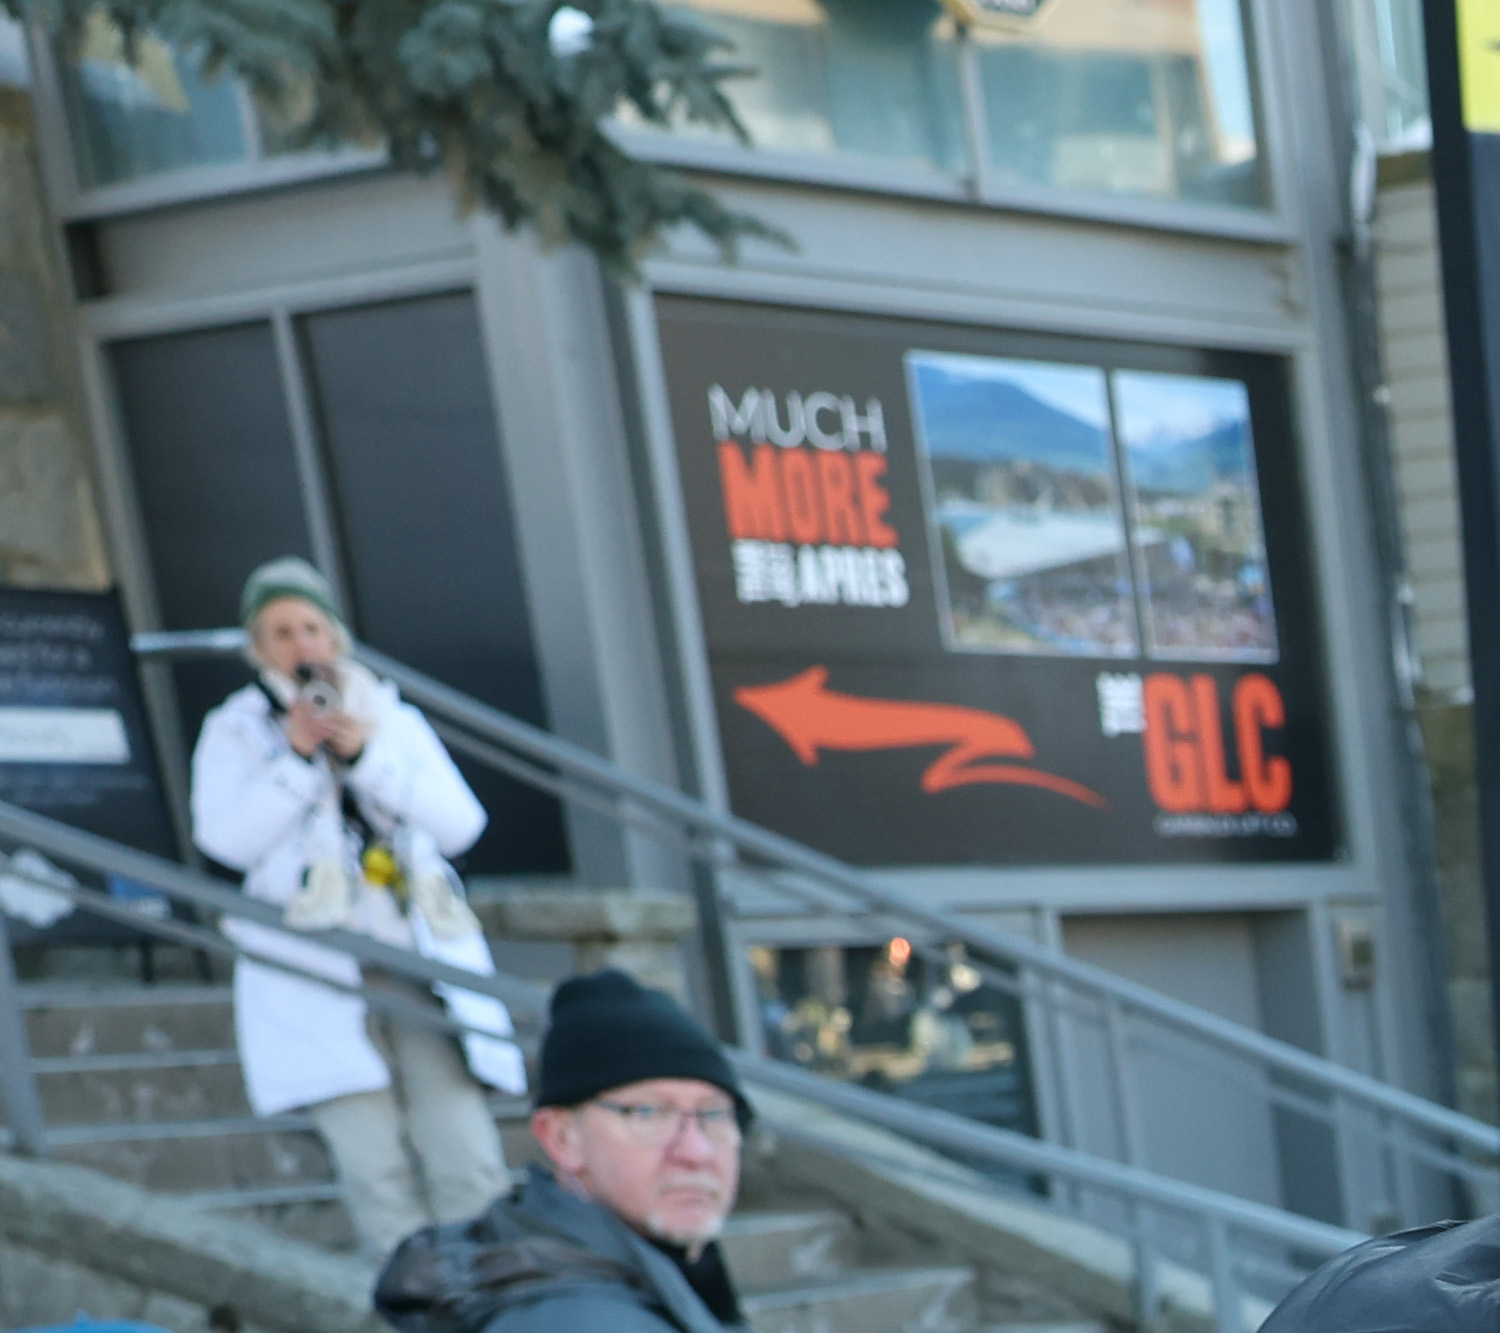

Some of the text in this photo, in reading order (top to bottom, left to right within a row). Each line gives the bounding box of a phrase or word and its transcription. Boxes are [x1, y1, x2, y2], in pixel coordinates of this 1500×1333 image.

[709, 383, 887, 451] MUCH
[718, 441, 897, 547] MORE
[1142, 671, 1293, 815] GLC
